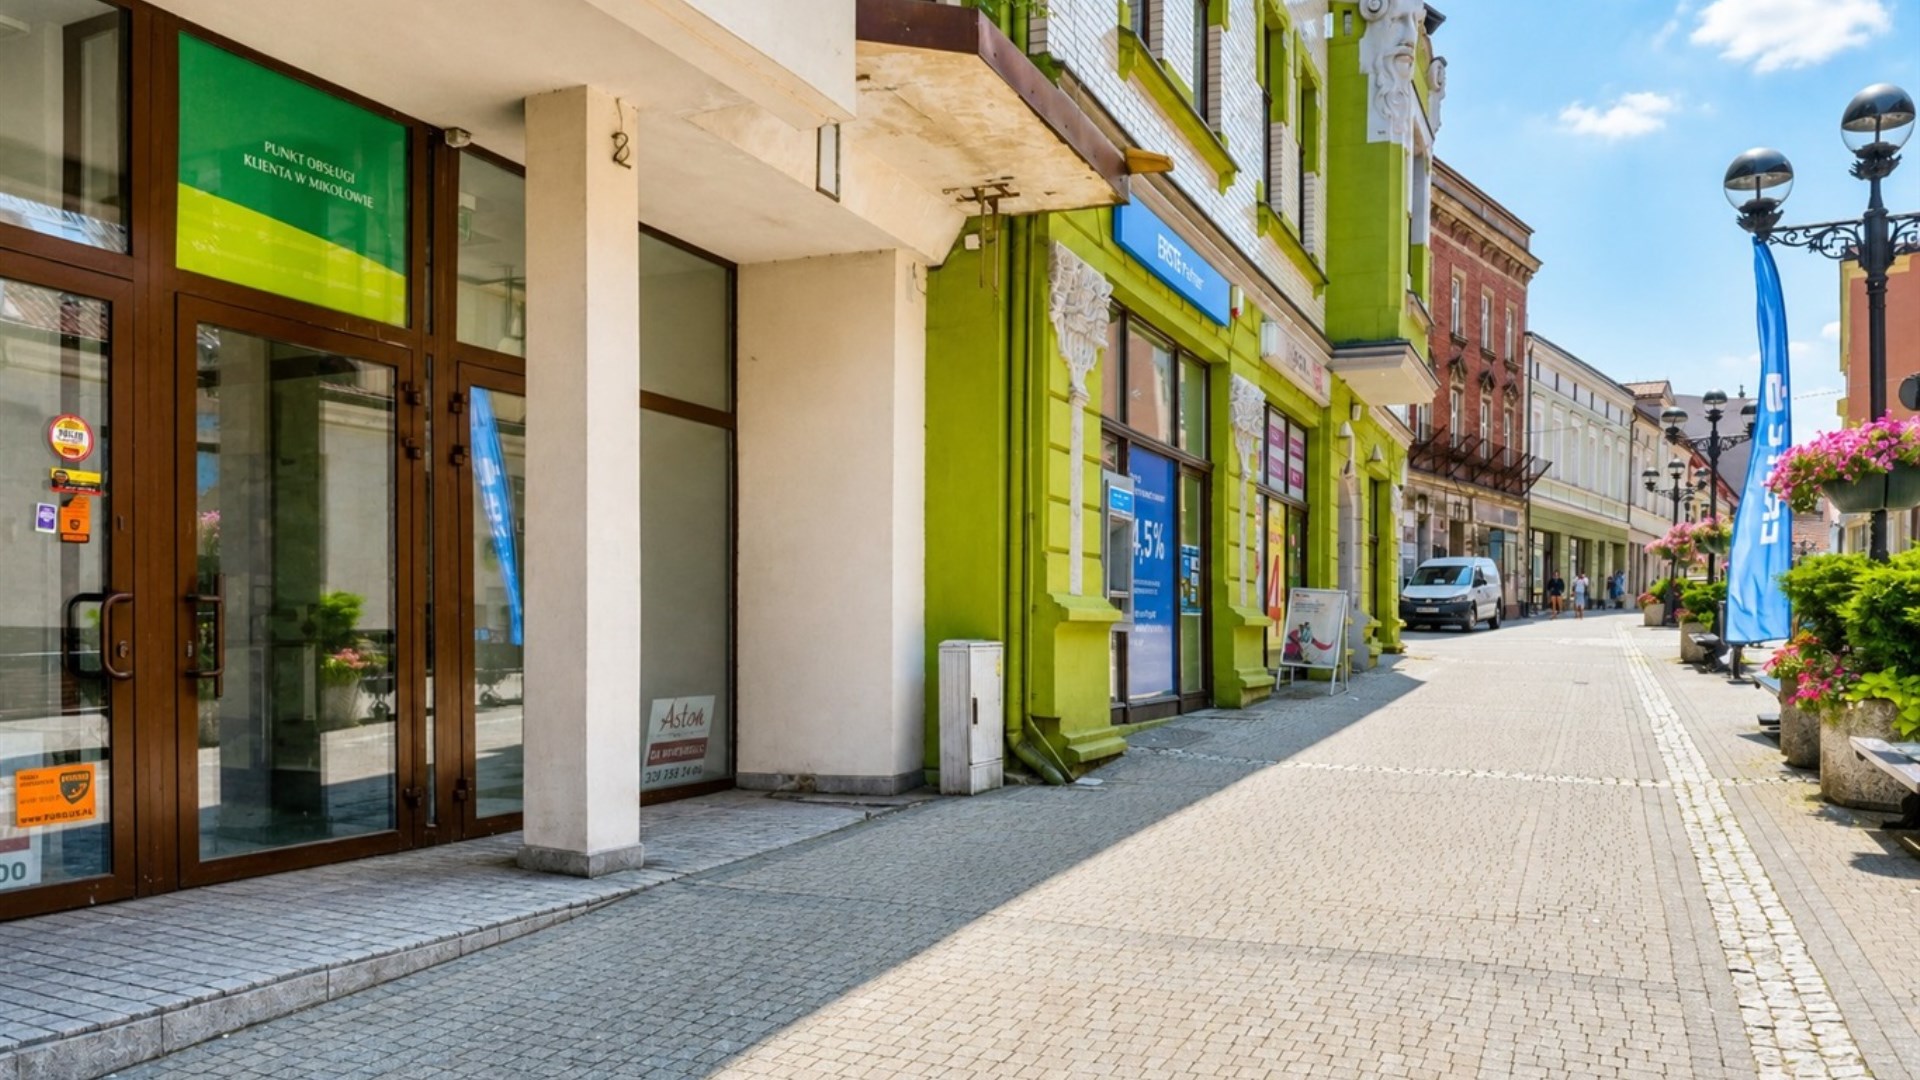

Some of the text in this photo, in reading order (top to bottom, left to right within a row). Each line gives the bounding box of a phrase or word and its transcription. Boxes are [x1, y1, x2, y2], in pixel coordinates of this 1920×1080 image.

[243, 153, 293, 181] KLIENTA
[294, 171, 307, 184] W
[264, 141, 355, 184] PUNKT OBSŁUGI
[660, 702, 705, 731] Aston
